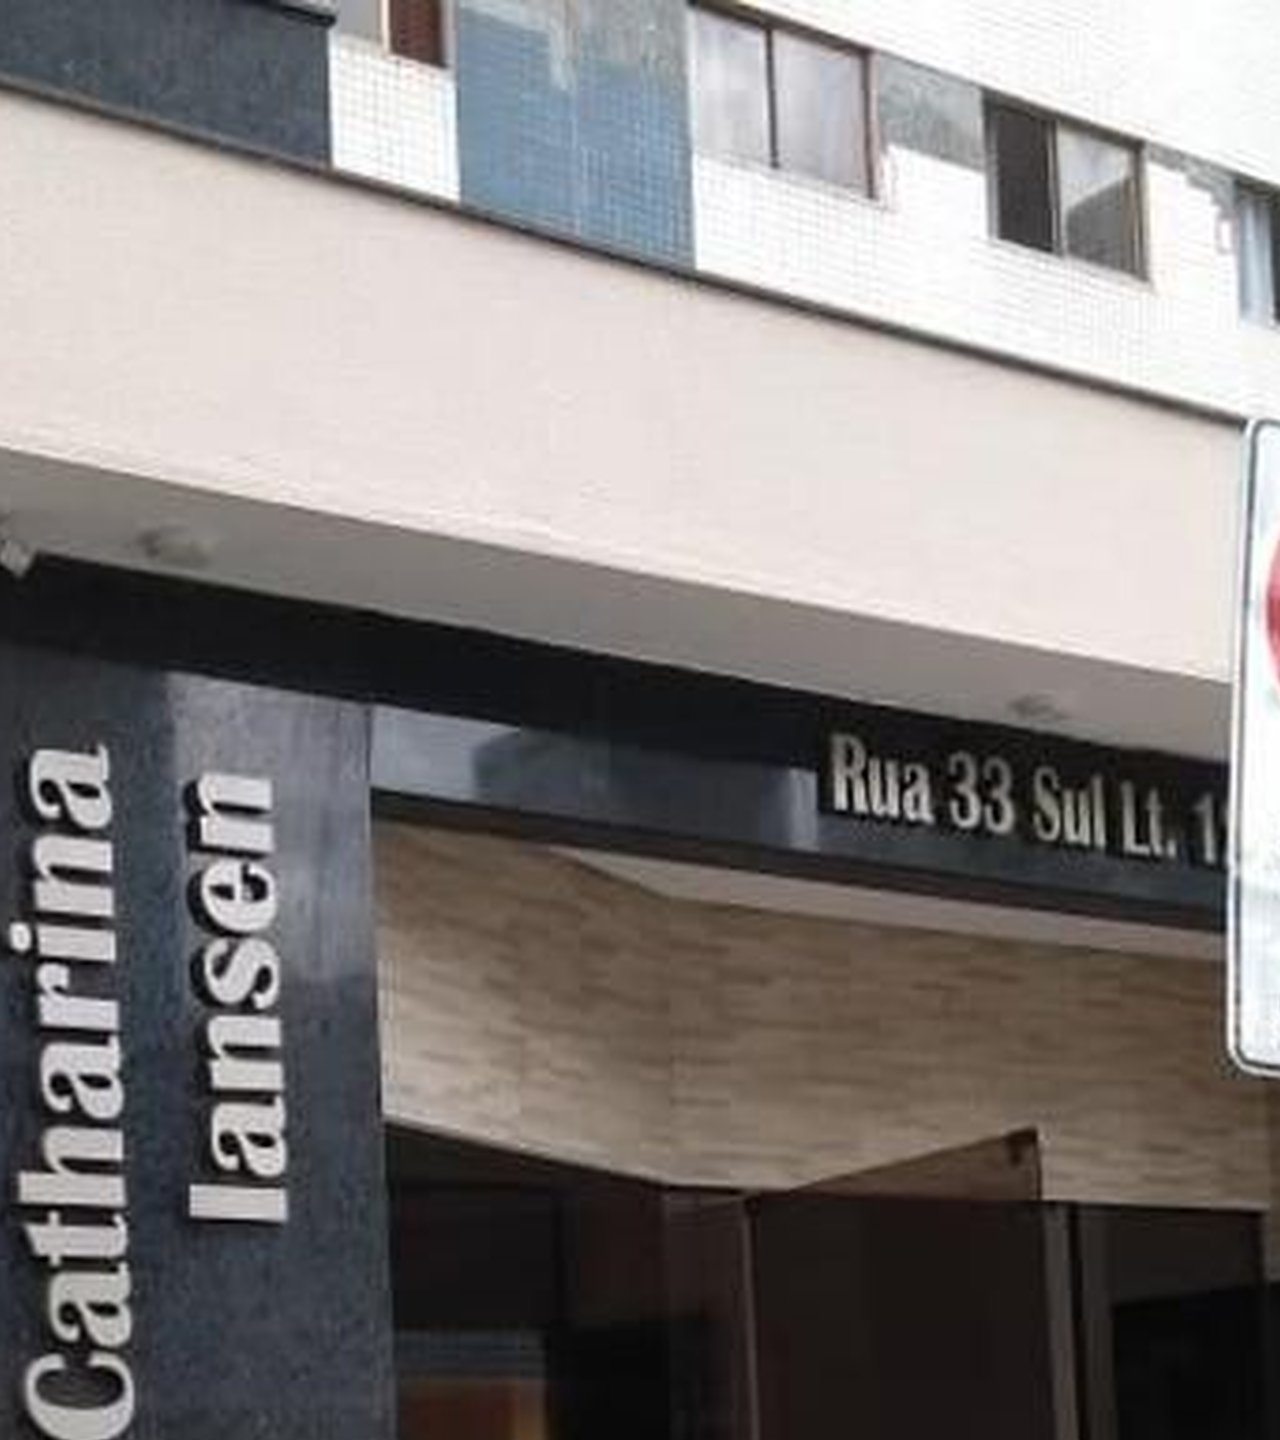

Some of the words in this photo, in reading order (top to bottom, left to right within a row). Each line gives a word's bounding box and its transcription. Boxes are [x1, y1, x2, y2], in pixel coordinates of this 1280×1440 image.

[831, 733, 934, 825] Rua
[947, 751, 1016, 834] 33
[1032, 768, 1106, 850] Sul
